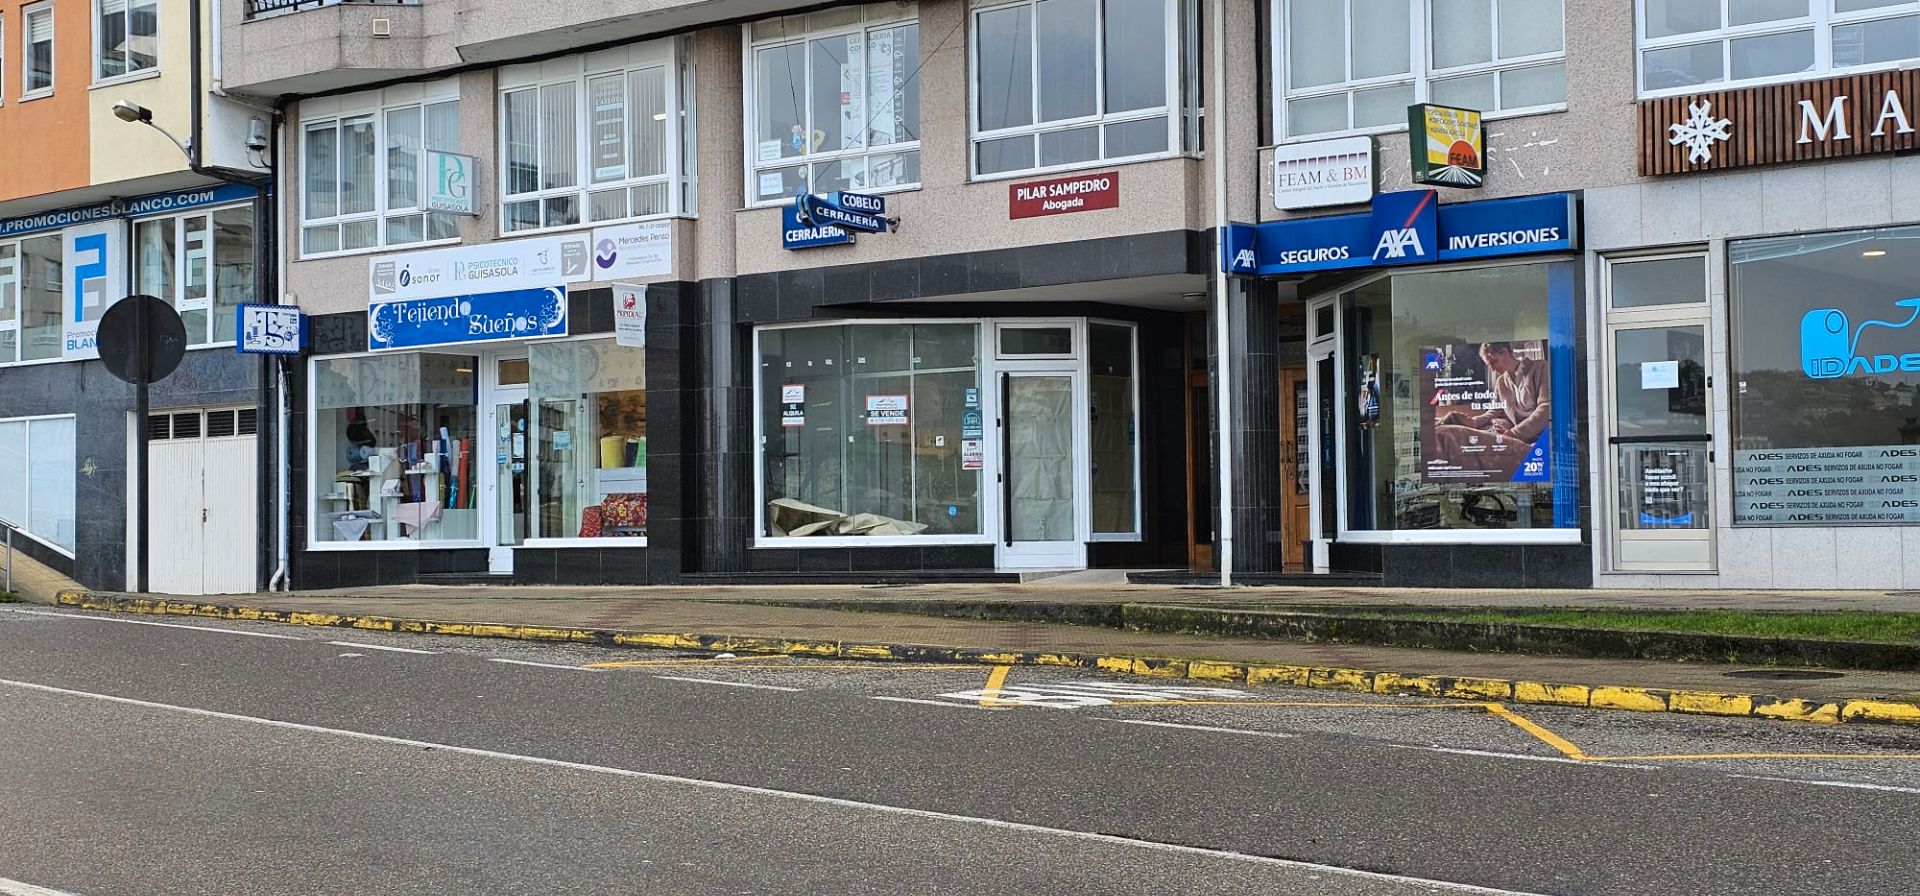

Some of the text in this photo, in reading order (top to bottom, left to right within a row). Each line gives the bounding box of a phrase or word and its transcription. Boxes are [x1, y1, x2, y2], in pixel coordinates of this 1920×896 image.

[1451, 152, 1478, 165] FEAM
[1279, 165, 1367, 188] FEAM & BM
[1016, 177, 1110, 201] PILAR SAMPEDRO
[431, 202, 469, 212] GUISASOLA
[842, 194, 881, 211] COBELO
[1042, 197, 1084, 212] Abogada
[816, 206, 879, 228] CERRAJERÍA
[618, 234, 649, 246] Mercedes
[1373, 227, 1425, 260] AXA
[1449, 227, 1559, 250] INVERSIONES
[1232, 248, 1256, 269] AXA
[1280, 246, 1349, 265] SEGUROS
[468, 266, 518, 280] GUISASOLA
[392, 297, 472, 329] Tejiendo
[469, 310, 538, 338] Sueños
[67, 330, 96, 339] Promoc
[67, 337, 97, 350] BLAN
[1426, 361, 1440, 370] AXA
[1434, 391, 1460, 402] Antes
[1462, 390, 1473, 401] de
[1471, 400, 1507, 410] tu salud
[1824, 464, 1848, 472] SERVIZOS
[1858, 463, 1875, 471] AXUDA
